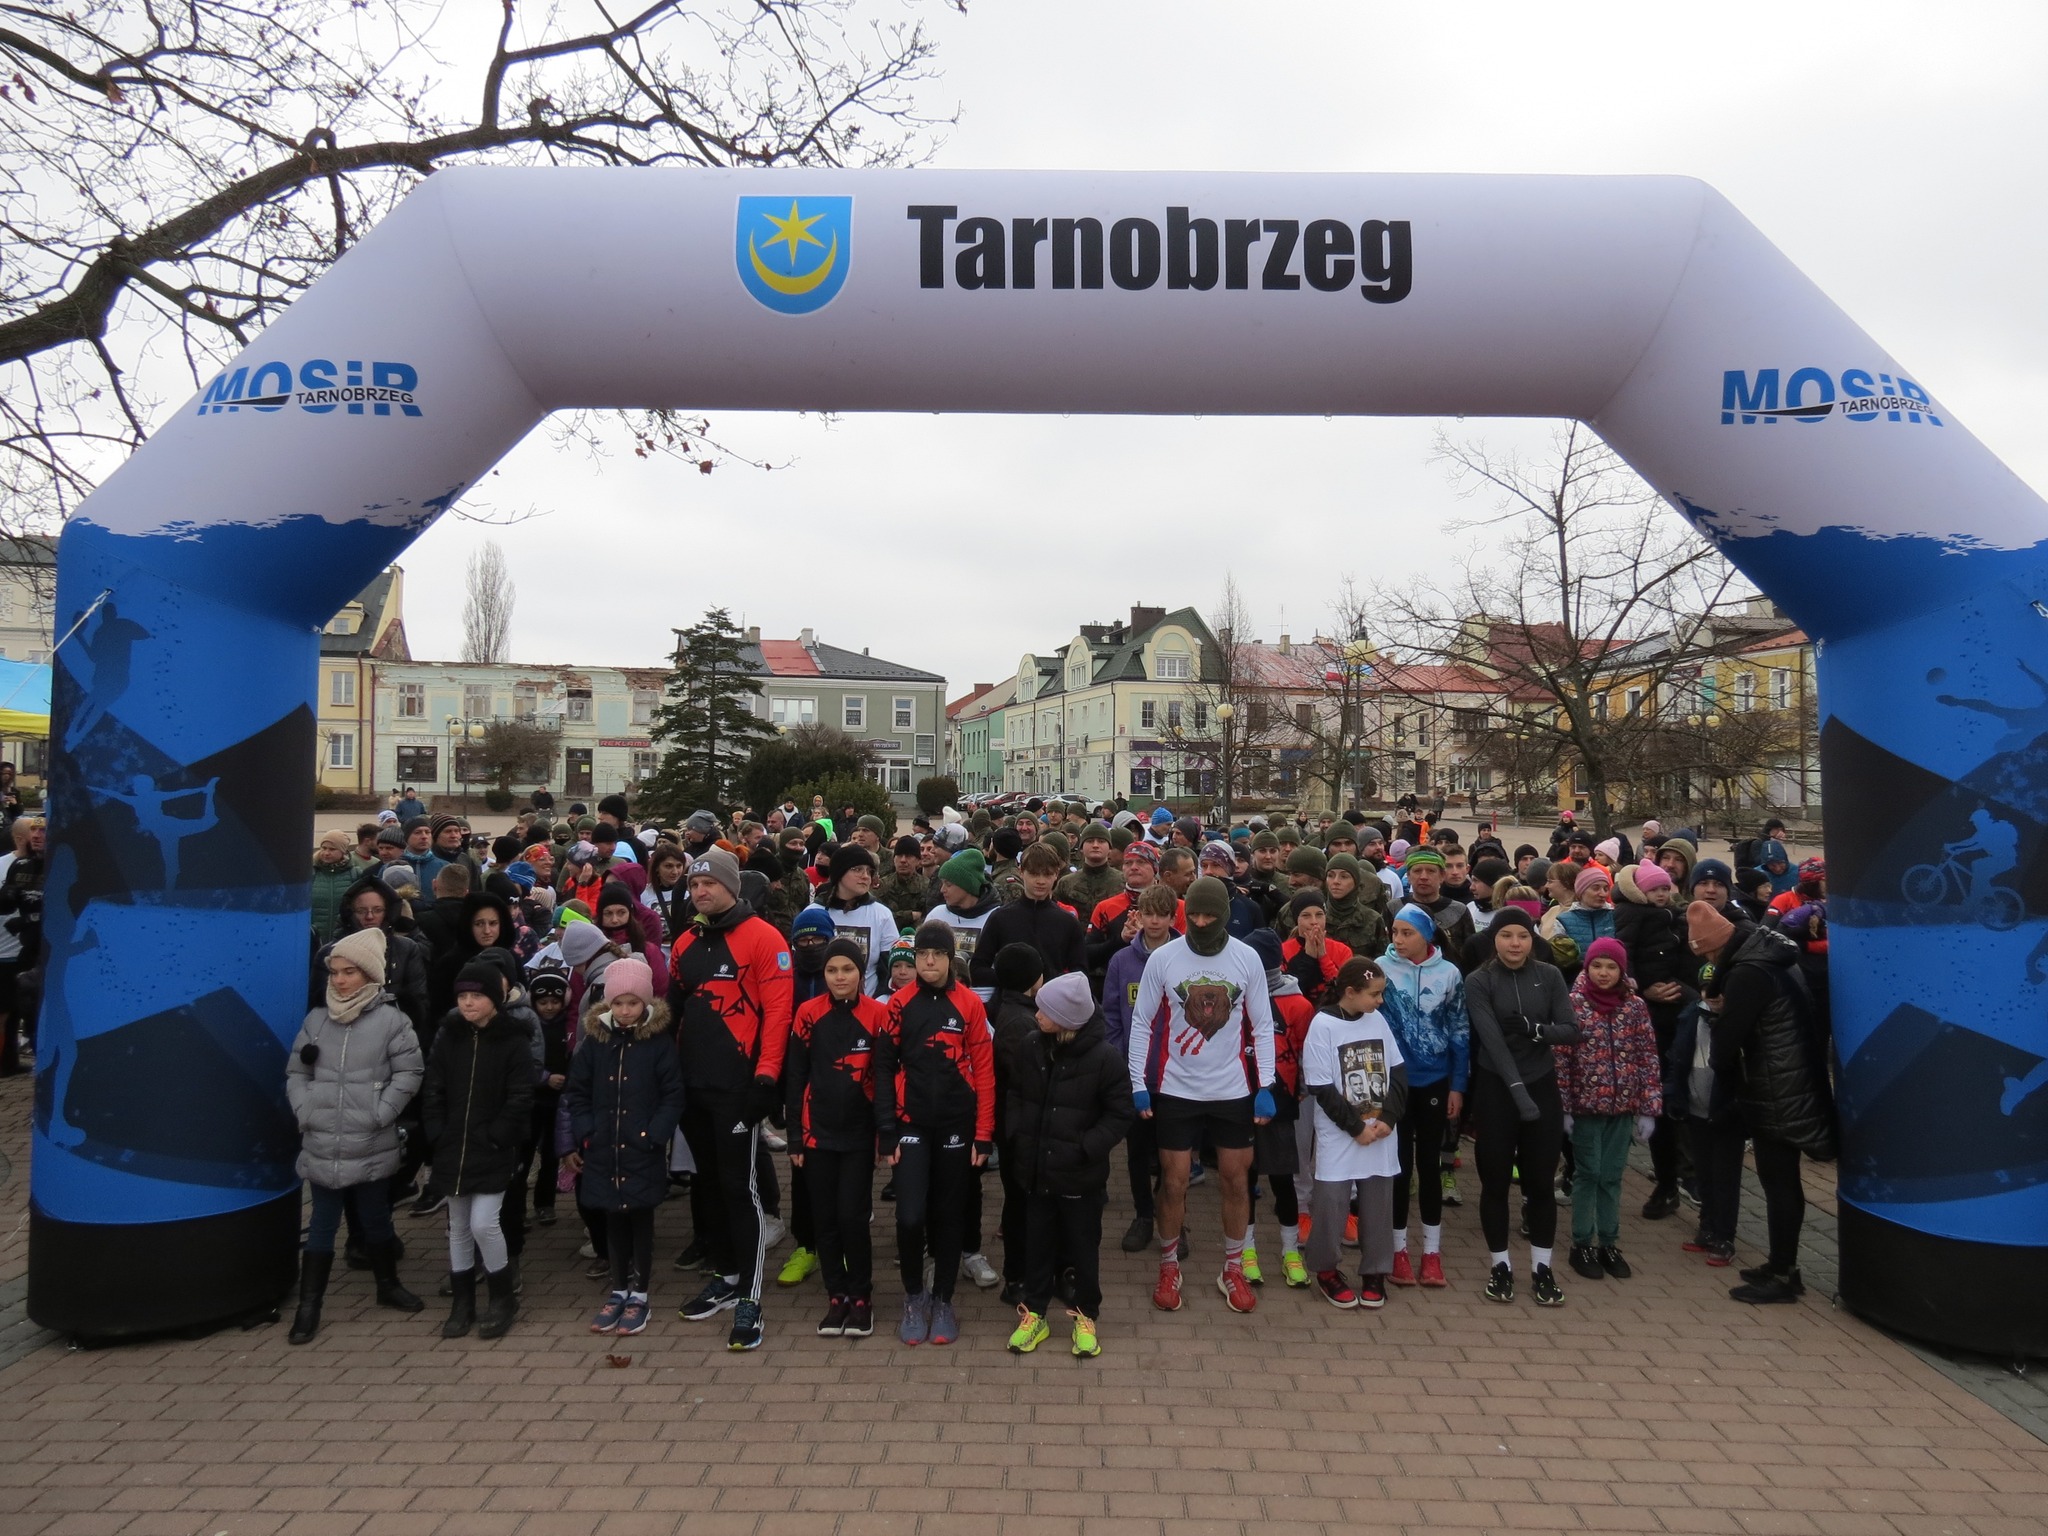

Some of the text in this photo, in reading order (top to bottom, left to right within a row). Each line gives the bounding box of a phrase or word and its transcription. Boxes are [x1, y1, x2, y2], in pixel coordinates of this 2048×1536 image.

[907, 205, 1413, 304] Tarnobrzeg
[295, 388, 414, 405] TARNOBRZEG
[1840, 397, 1933, 415] TARNOBRZEG
